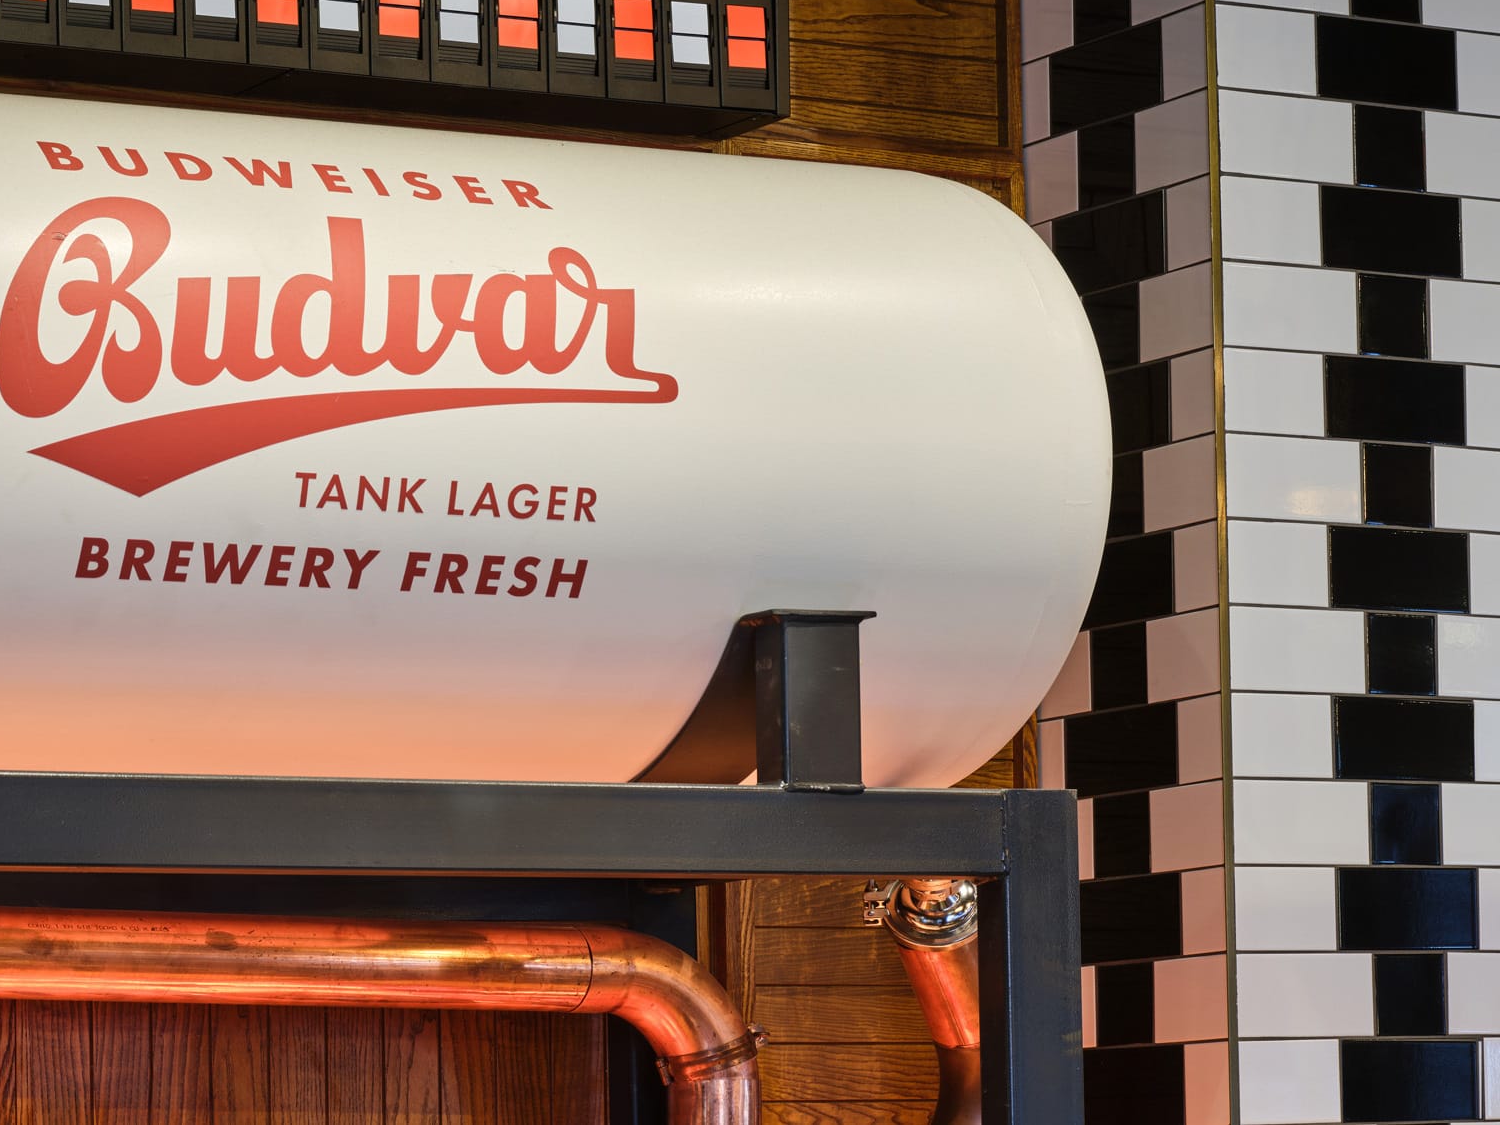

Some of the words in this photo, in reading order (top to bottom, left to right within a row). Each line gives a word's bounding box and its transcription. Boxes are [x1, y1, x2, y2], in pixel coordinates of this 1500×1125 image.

[37, 140, 553, 210] BUDWEISER
[295, 472, 427, 514] TANK
[447, 480, 597, 523] LAGER
[75, 537, 380, 590] BREWERY
[400, 552, 589, 599] FRESH
